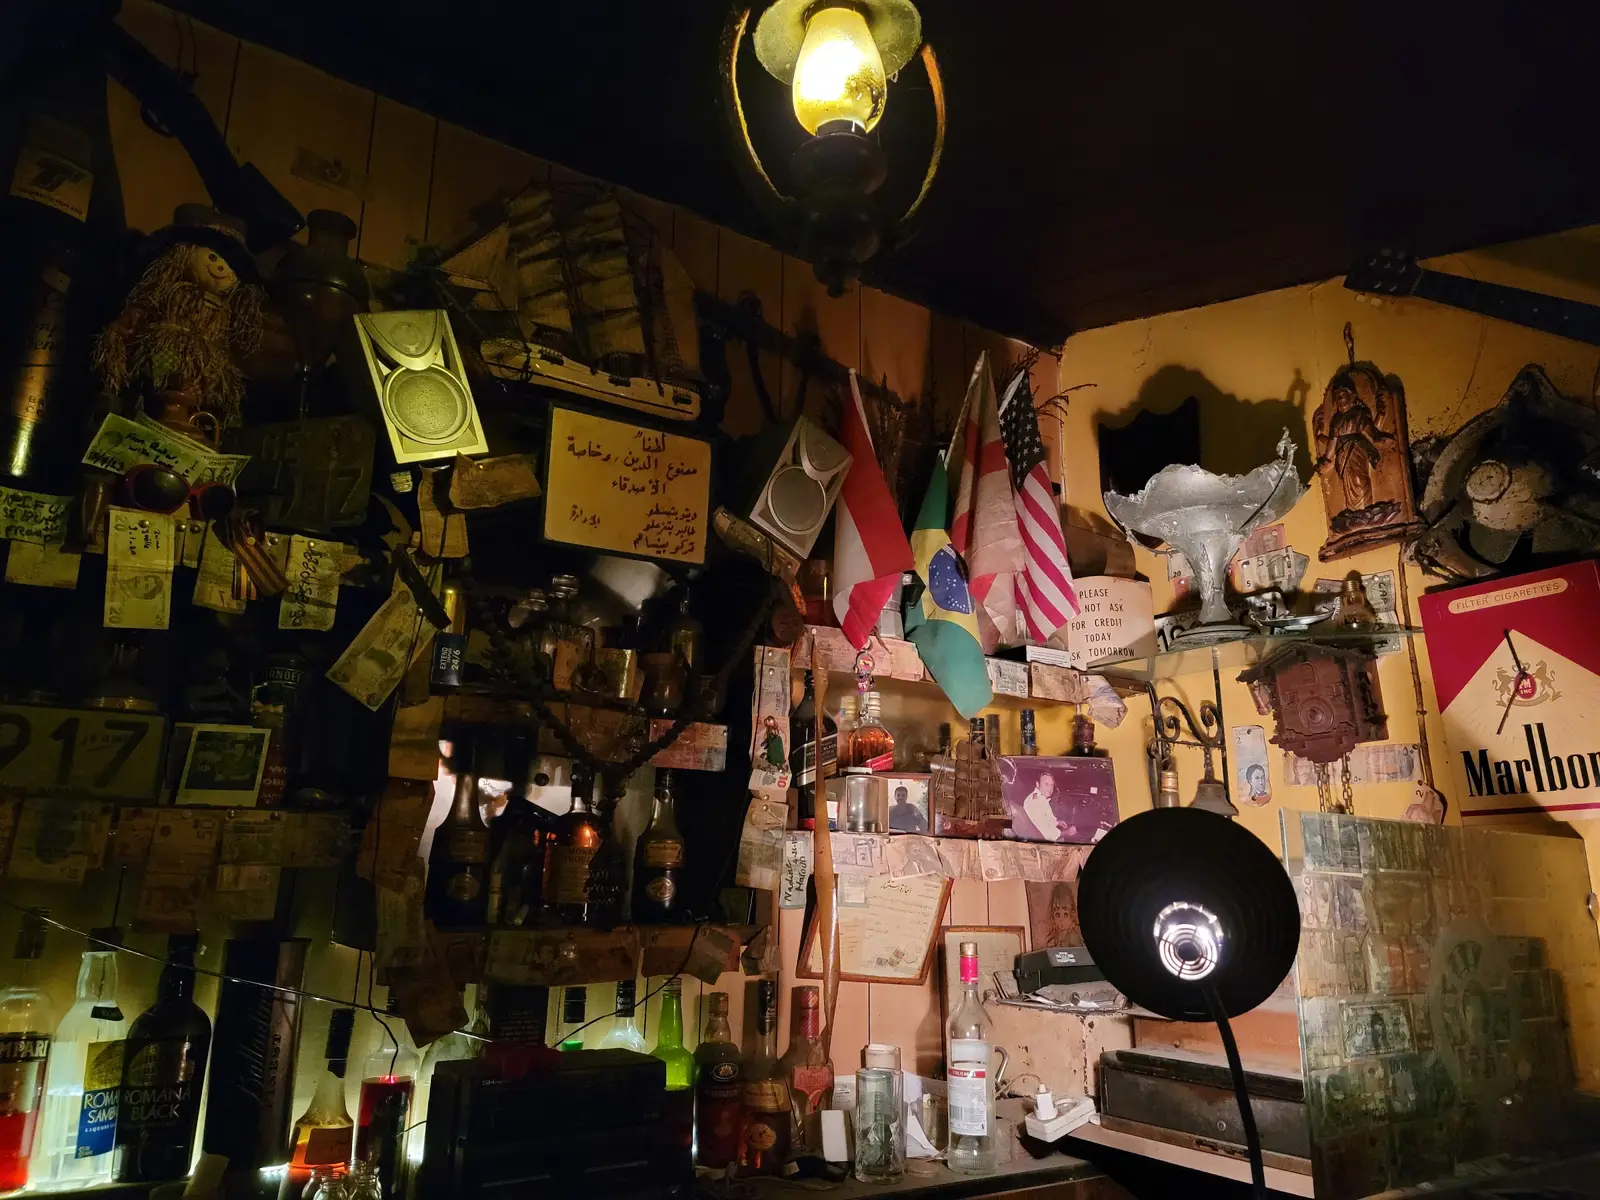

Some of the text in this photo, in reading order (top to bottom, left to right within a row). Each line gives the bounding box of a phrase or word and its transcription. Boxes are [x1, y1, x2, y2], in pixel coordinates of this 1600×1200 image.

[1256, 557, 1265, 567] 5
[1079, 588, 1109, 599] PLEASE
[1456, 582, 1560, 610] FILTER CIGARETTES
[1084, 602, 1125, 613] NOT ASK
[1071, 618, 1123, 632] FOR CREDIT
[1085, 632, 1112, 643] TODAY
[1088, 647, 1135, 658] TOMORROW
[1460, 722, 1600, 797] Marlbor
[783, 858, 795, 902] Nadine
[0, 1040, 49, 1058] MPARI
[83, 1088, 121, 1109] ROMA
[124, 1084, 192, 1106] ROMANA
[131, 1103, 181, 1121] BLACK
